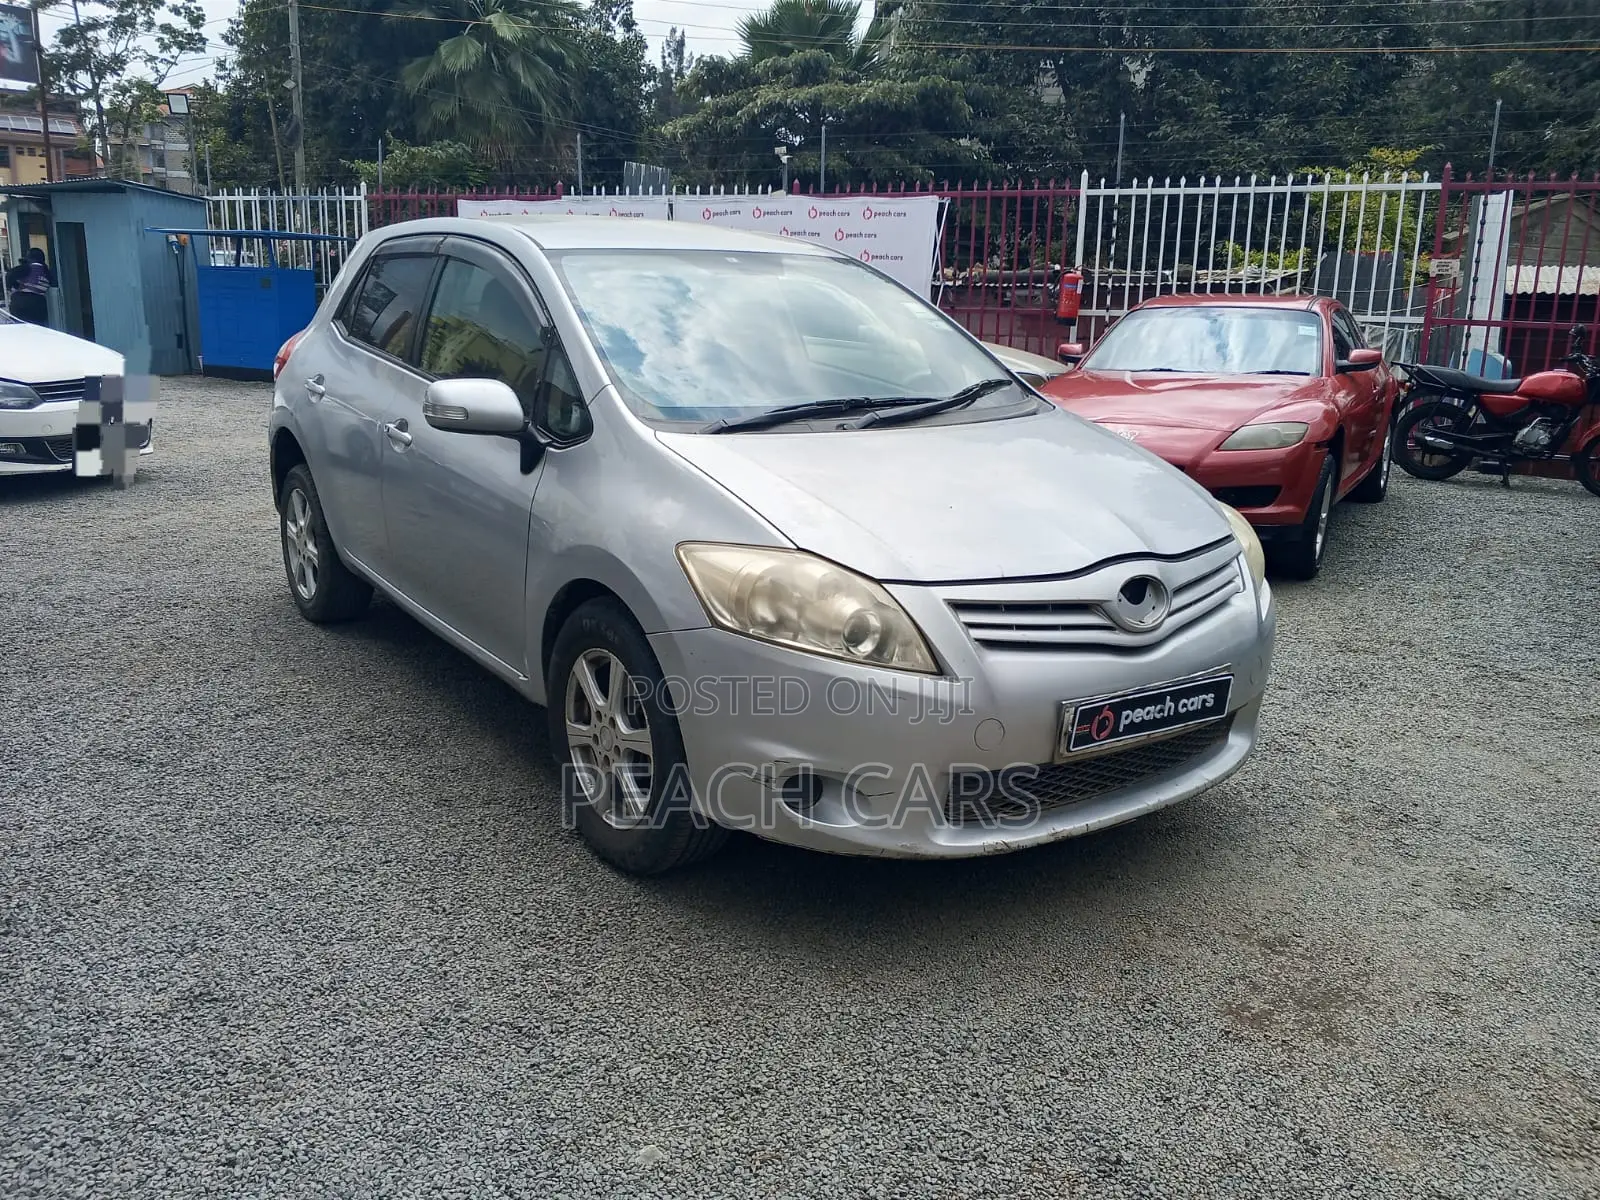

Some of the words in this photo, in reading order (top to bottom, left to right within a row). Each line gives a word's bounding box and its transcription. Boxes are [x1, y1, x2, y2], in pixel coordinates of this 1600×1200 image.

[712, 209, 729, 218] peach
[763, 209, 780, 218] peach
[819, 209, 836, 218] peach
[873, 209, 892, 219] peach
[845, 231, 863, 239] peach
[871, 253, 889, 261] peach
[1119, 696, 1174, 732] peach
[1178, 693, 1215, 714] cars
